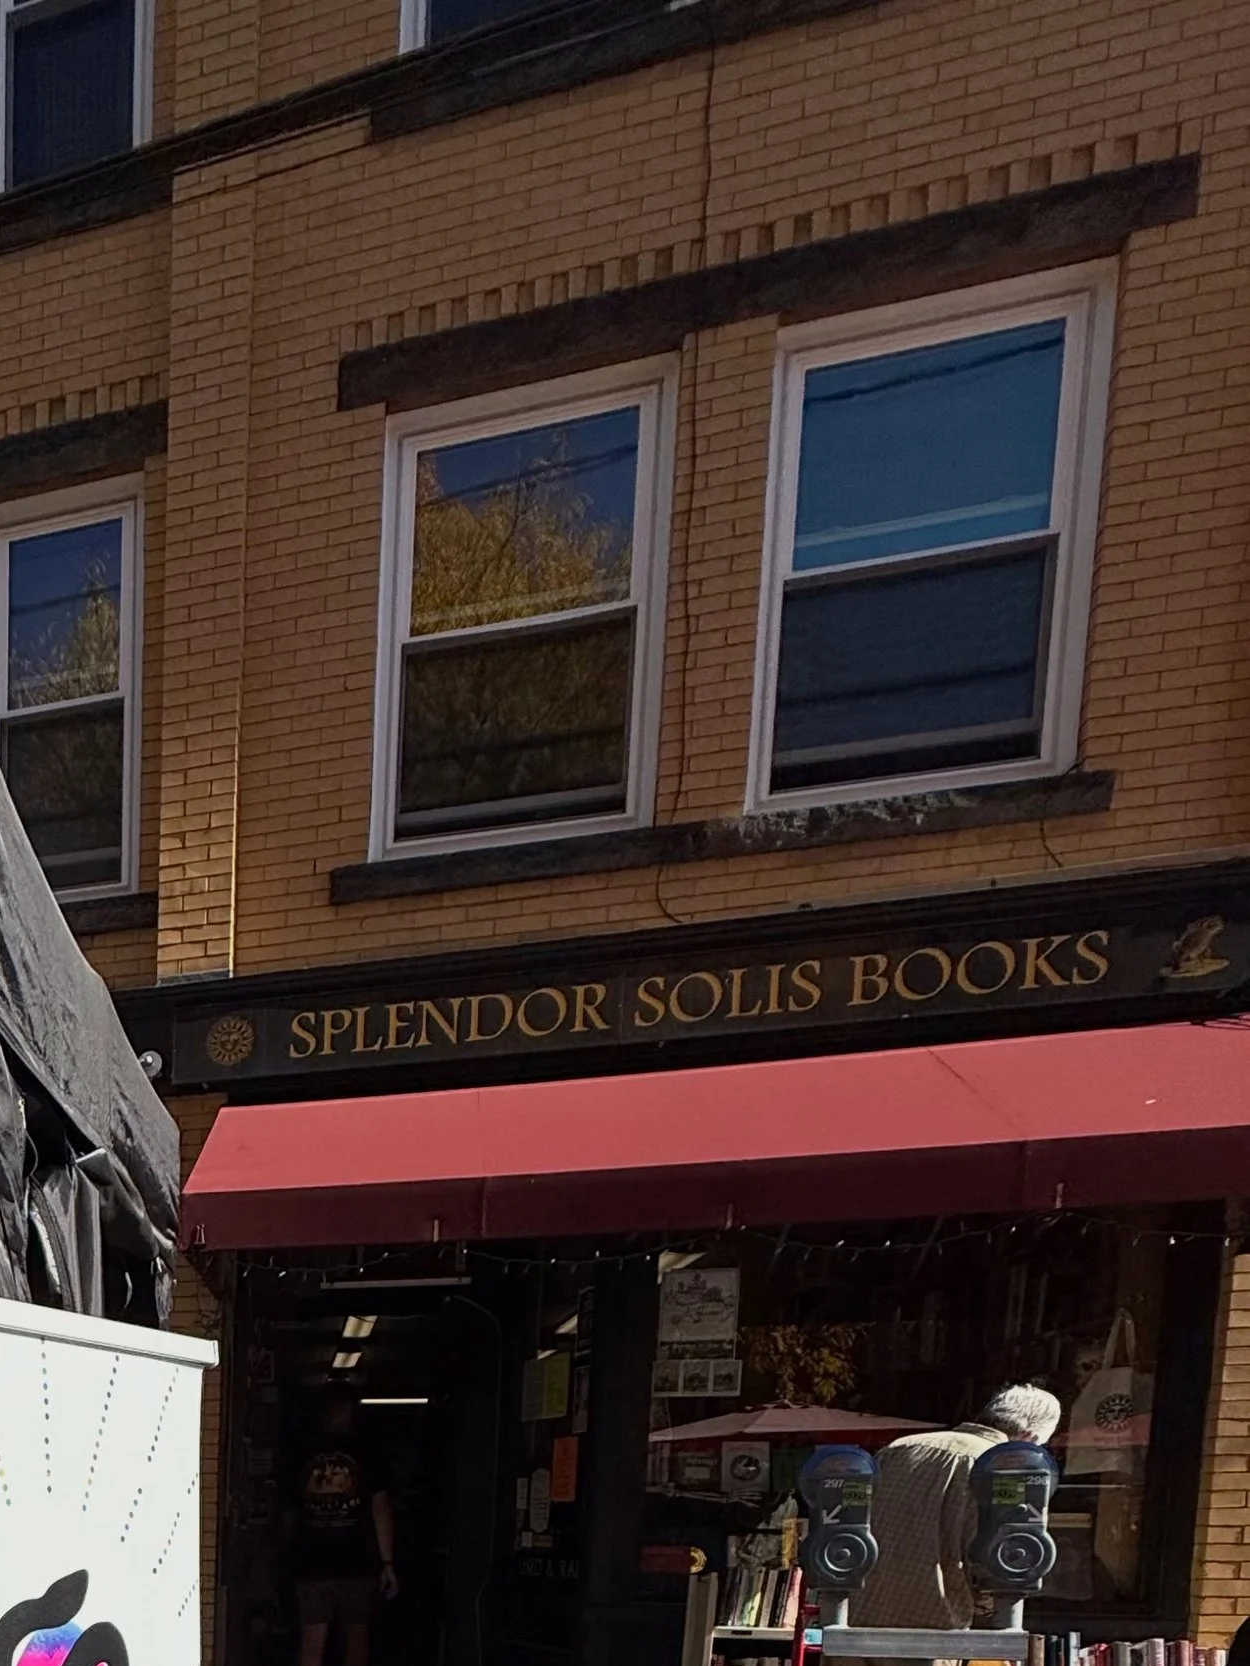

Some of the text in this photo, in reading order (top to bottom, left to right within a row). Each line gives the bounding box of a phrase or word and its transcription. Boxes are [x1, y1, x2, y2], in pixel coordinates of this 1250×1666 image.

[289, 930, 1110, 1059] SPLENDOR SOLIS BOOKS
[824, 1478, 845, 1489] 297
